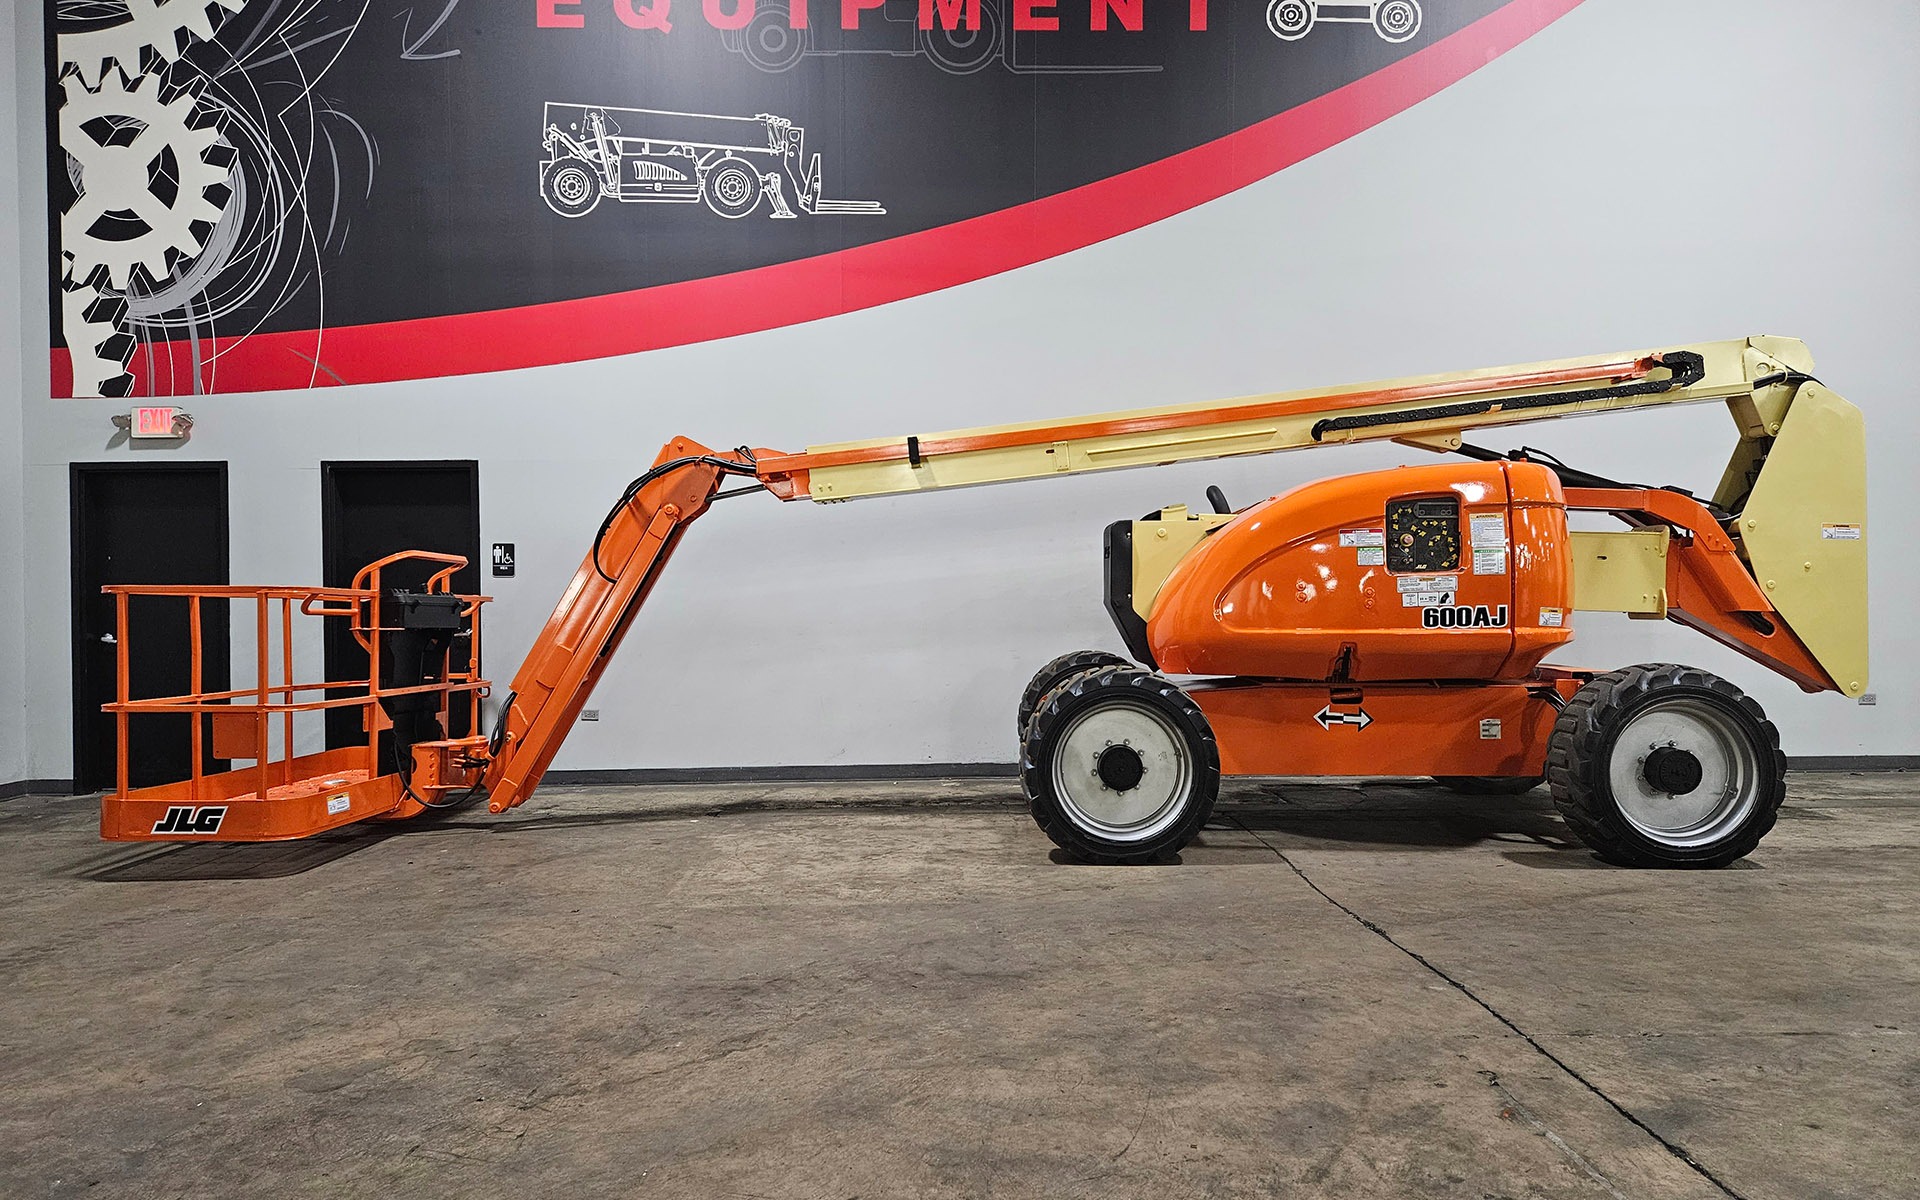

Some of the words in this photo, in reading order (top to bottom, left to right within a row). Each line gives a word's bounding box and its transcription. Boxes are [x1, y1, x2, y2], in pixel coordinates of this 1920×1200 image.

[139, 408, 172, 433] EXIT
[1422, 605, 1508, 628] 600AJ
[151, 806, 228, 834] JLG
